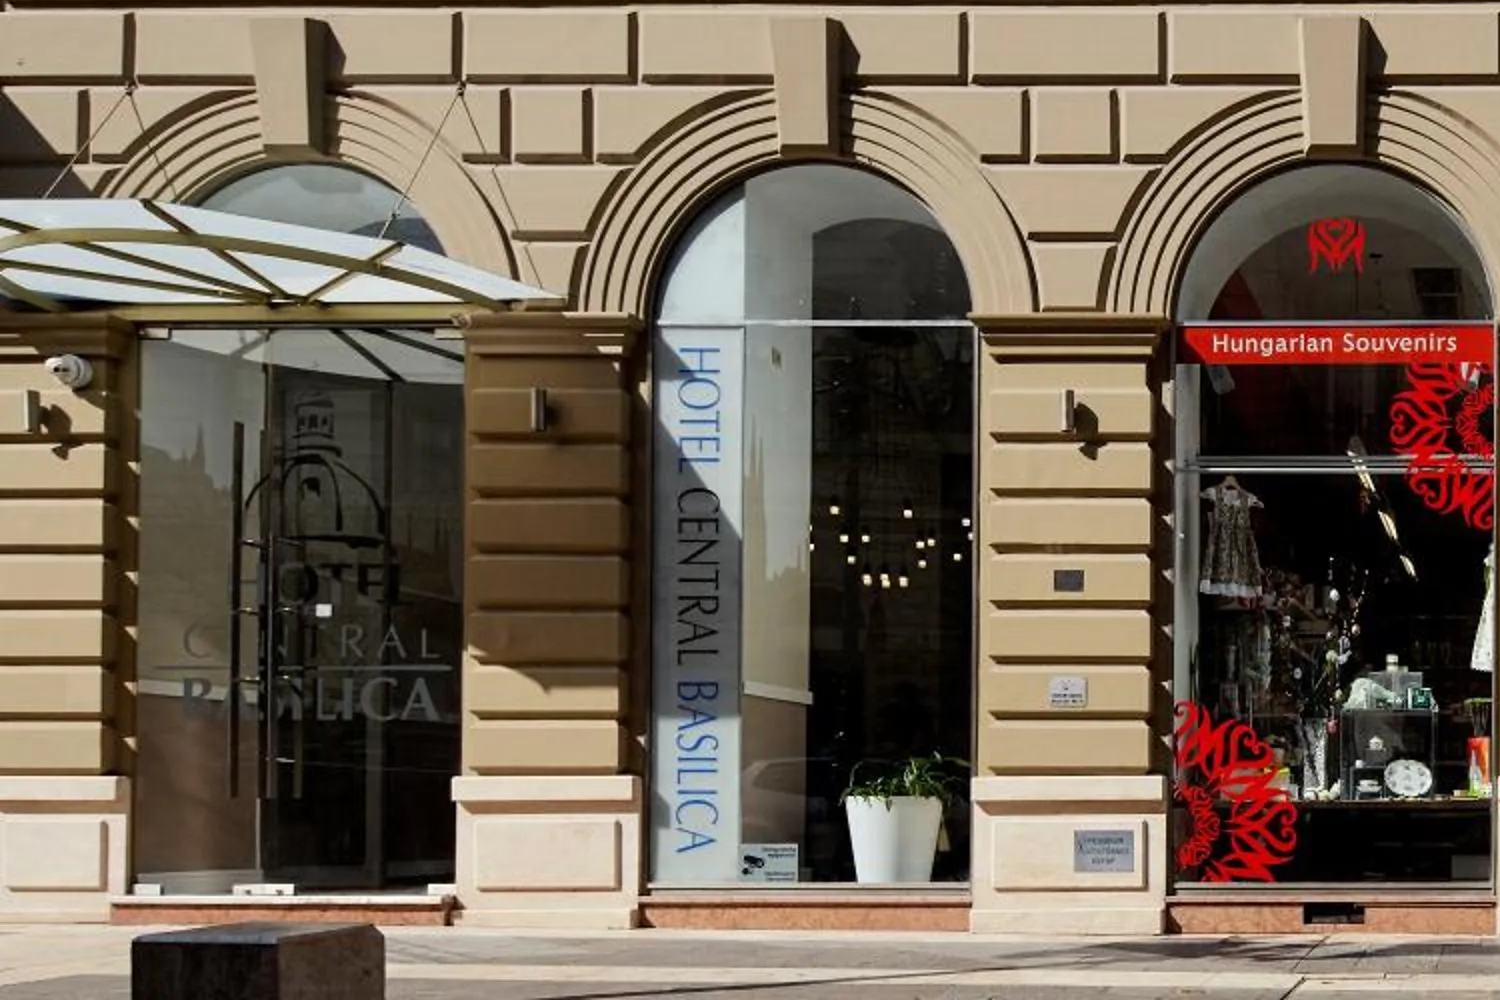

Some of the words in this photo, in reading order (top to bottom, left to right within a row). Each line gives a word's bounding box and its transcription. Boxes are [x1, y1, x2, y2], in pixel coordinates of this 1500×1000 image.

[677, 347, 721, 473] HOTEL
[1213, 333, 1333, 356] Hungarian
[1343, 332, 1457, 353] Souvenirs
[677, 487, 720, 667] CENTRAL
[675, 680, 720, 855] BASILICA
